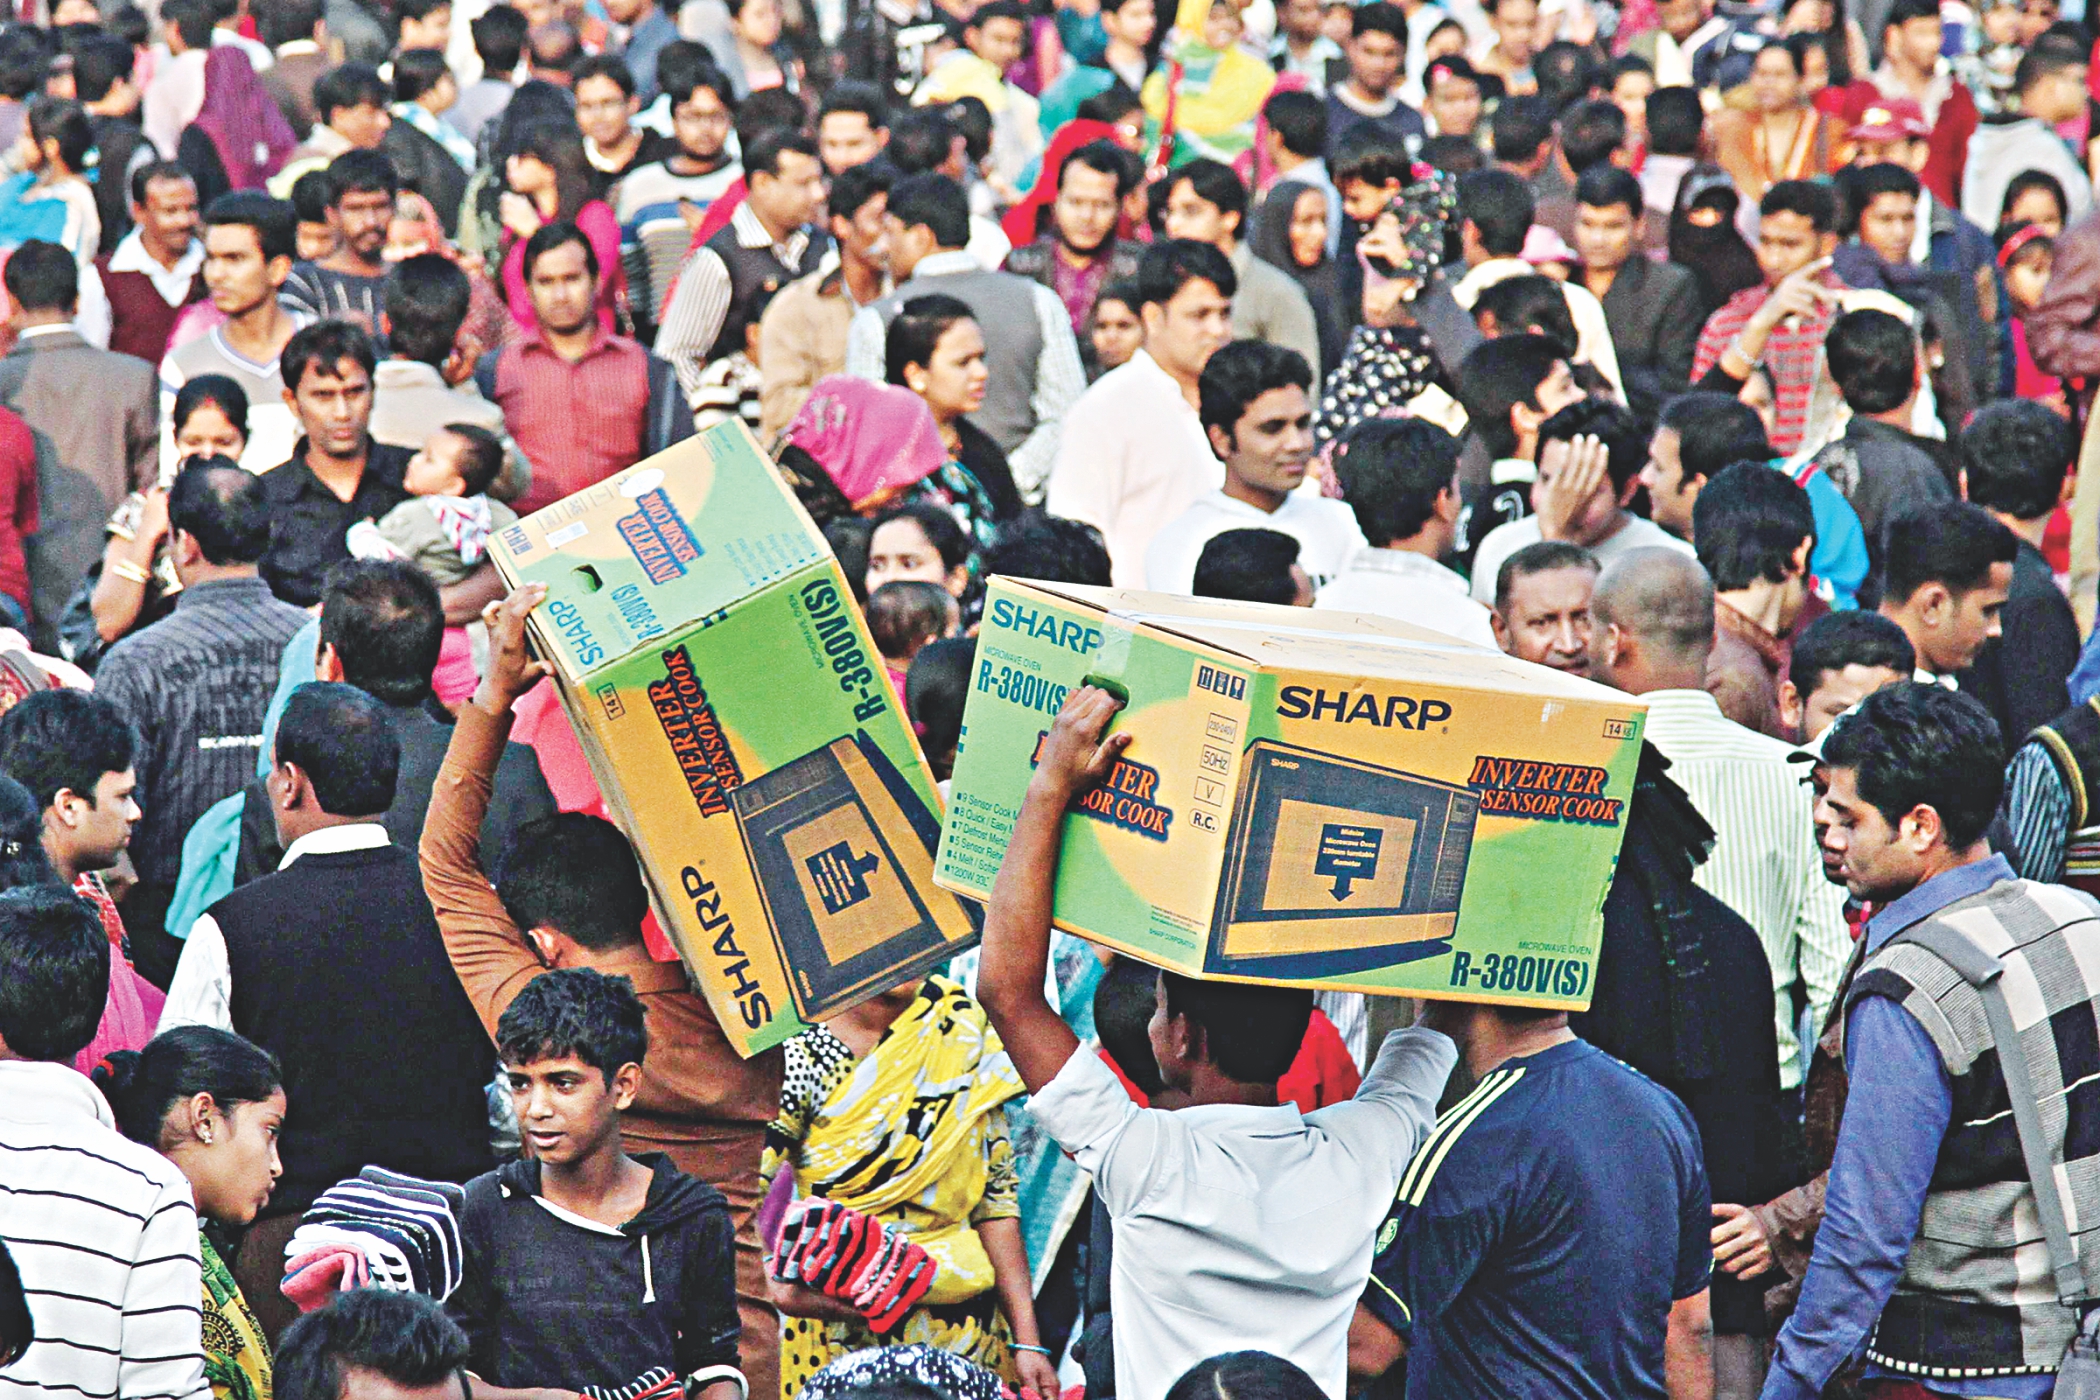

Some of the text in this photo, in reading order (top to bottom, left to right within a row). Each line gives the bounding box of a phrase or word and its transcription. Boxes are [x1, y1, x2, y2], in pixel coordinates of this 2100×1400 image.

[549, 601, 603, 665] SHARP
[991, 598, 1106, 655] SHARP
[800, 579, 887, 722] R-380V(S)
[977, 659, 1070, 716] R-380V(S
[1276, 685, 1452, 731] SHARP
[665, 651, 740, 789] SENSOR COOK
[1609, 723, 1621, 735] 14
[649, 681, 728, 817] INVERTER
[1203, 751, 1228, 770] 50Hz
[1469, 757, 1606, 795] INVERTER
[1116, 798, 1169, 834] COOK
[1193, 812, 1216, 831] R.C.
[1481, 789, 1621, 821] SENSOR COOK
[681, 866, 773, 1029] SHARP
[1518, 941, 1592, 955] MICROWAVE OVEN
[1450, 951, 1589, 996] R-380V(S)
